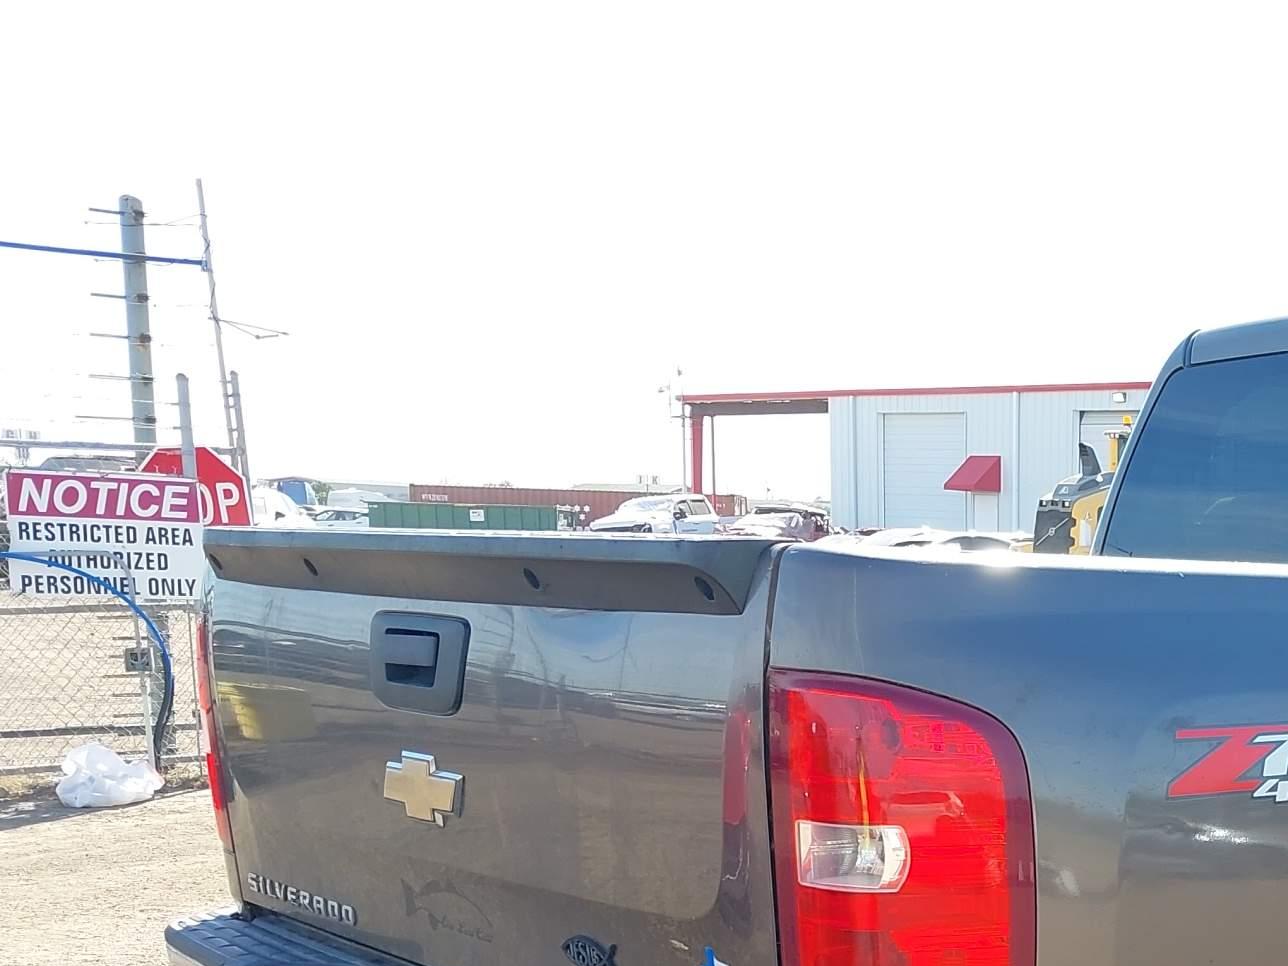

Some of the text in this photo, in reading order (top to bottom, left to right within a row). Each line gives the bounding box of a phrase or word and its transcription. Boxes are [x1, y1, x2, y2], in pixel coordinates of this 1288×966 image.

[18, 478, 190, 519] NOTICE
[199, 482, 240, 526] OP
[18, 521, 194, 547] RESTRICTED AREA
[21, 574, 197, 598] PERSONNEL ONLY
[247, 872, 355, 926] SILVERADO
